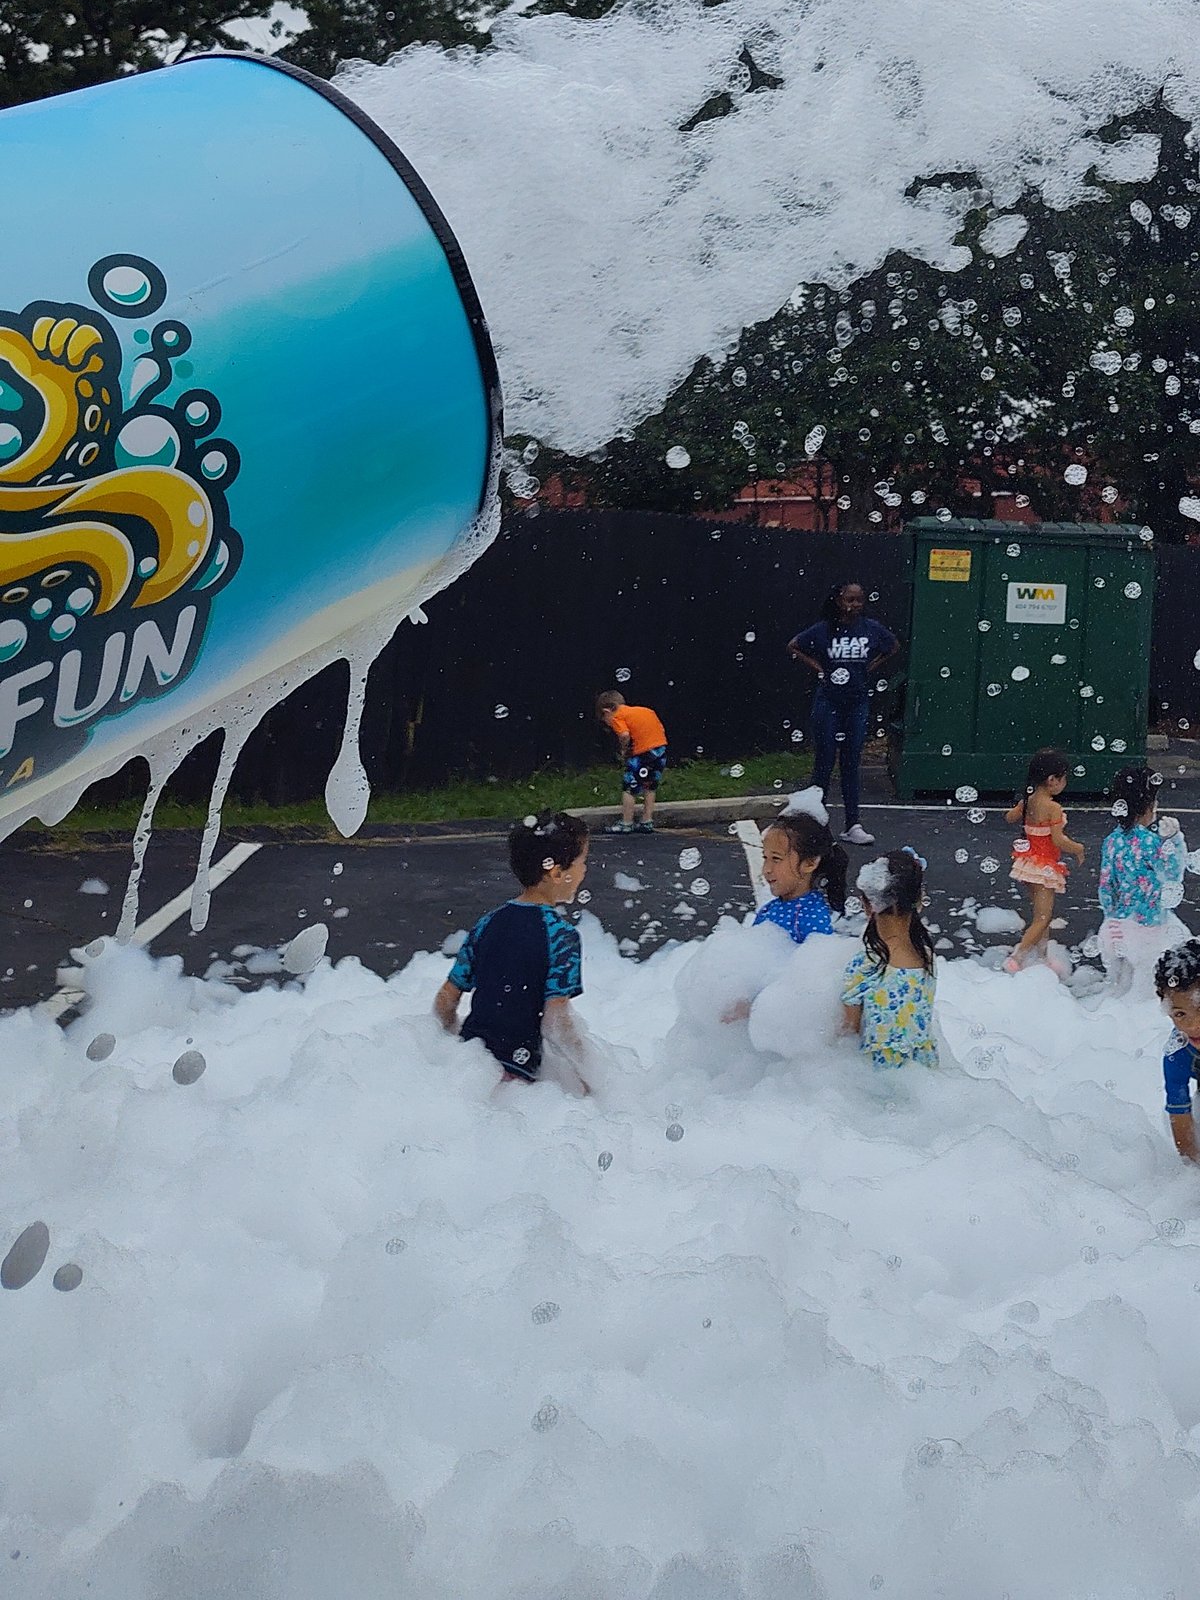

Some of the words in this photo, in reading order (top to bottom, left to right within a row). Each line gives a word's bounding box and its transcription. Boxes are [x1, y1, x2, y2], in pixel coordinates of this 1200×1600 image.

[1016, 587, 1055, 600] WM
[832, 636, 869, 648] LEAP
[827, 646, 870, 659] WEEK
[0, 605, 197, 758] FUN
